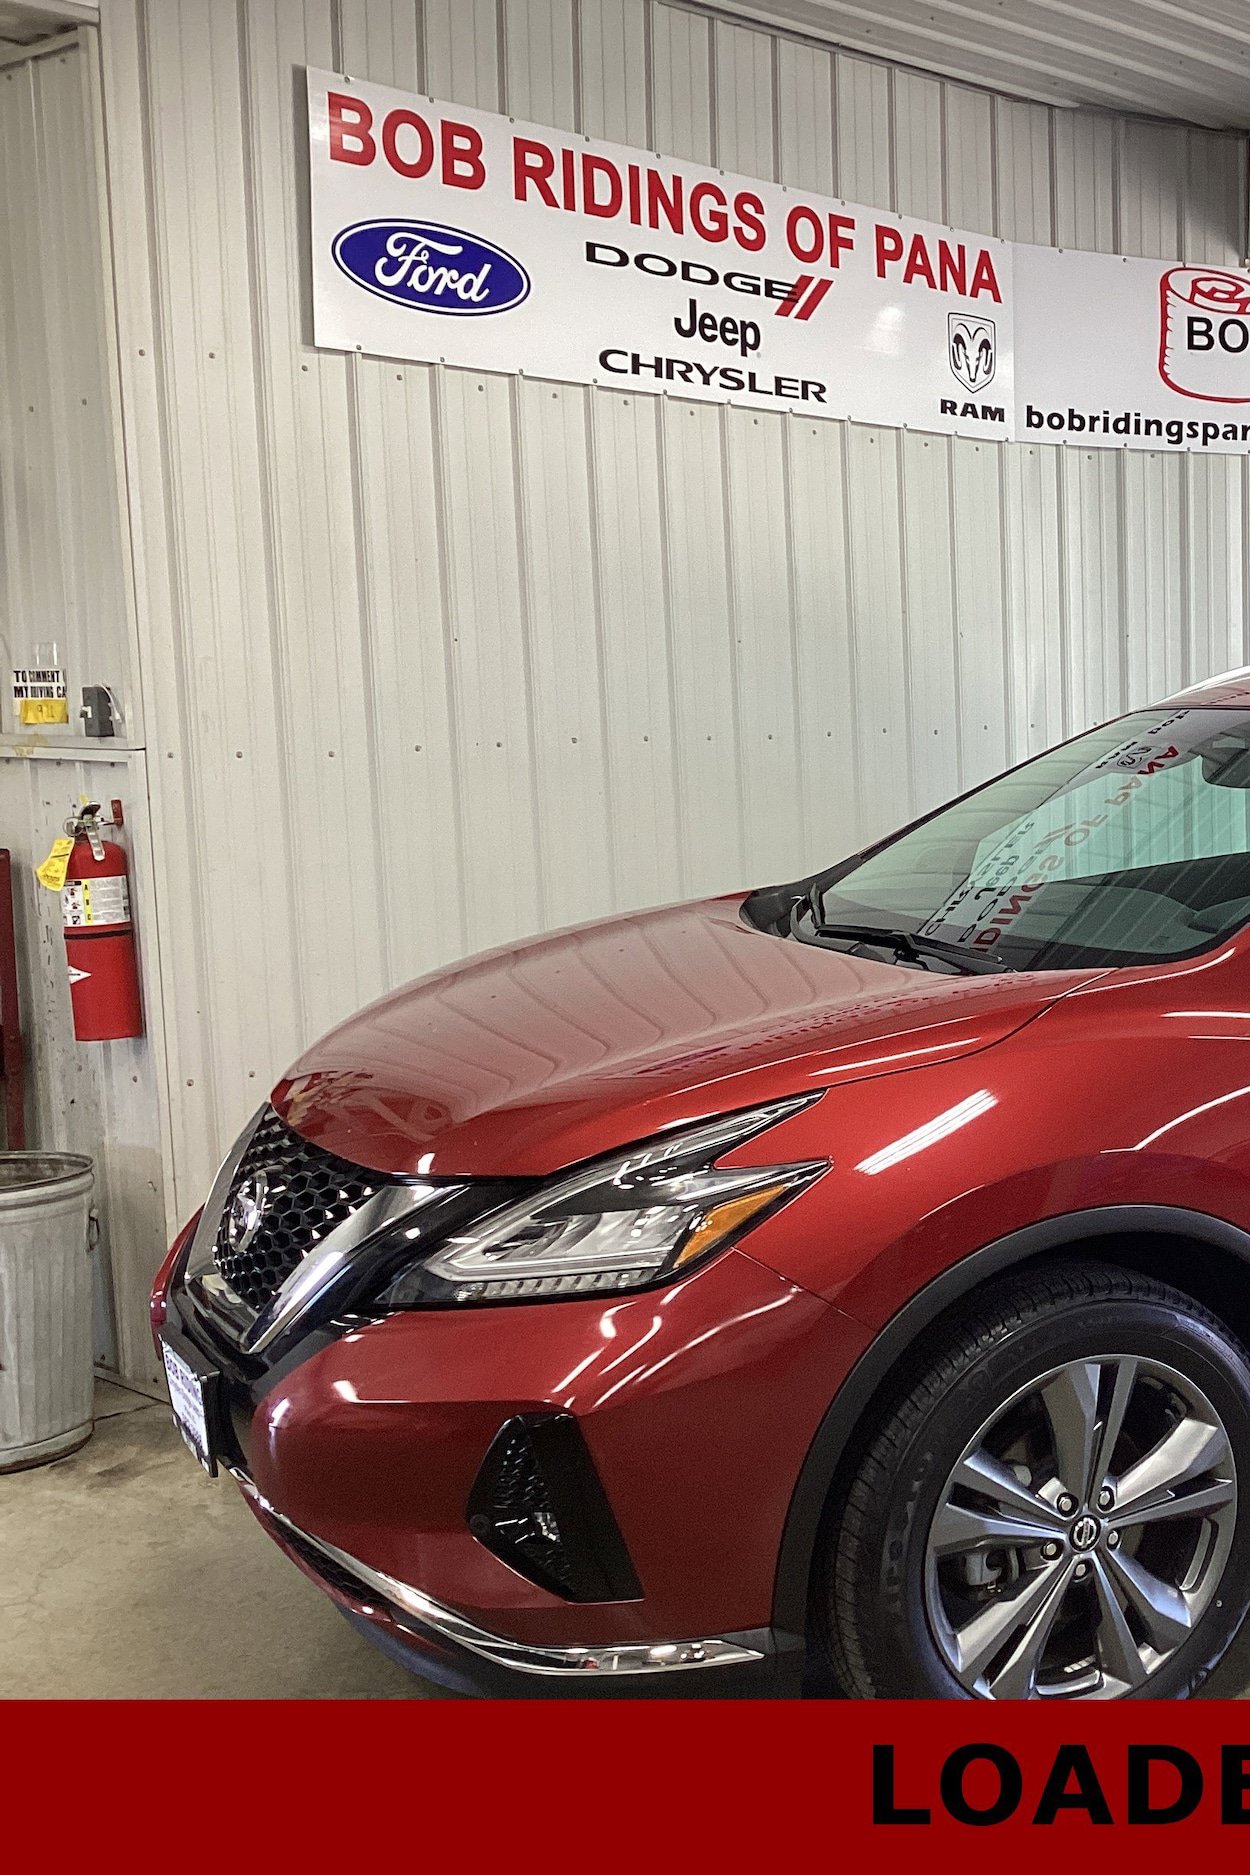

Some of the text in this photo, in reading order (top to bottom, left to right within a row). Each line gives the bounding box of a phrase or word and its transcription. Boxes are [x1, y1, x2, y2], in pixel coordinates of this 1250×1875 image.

[328, 92, 1002, 304] BOB RIDINGS OF PANA
[374, 231, 492, 303] Ford
[585, 241, 799, 304] DODGE
[674, 298, 761, 358] Jeep
[599, 349, 828, 404] CHRYSLER
[940, 398, 1005, 423] RAM
[13, 670, 28, 683] TO
[13, 686, 29, 698] MY
